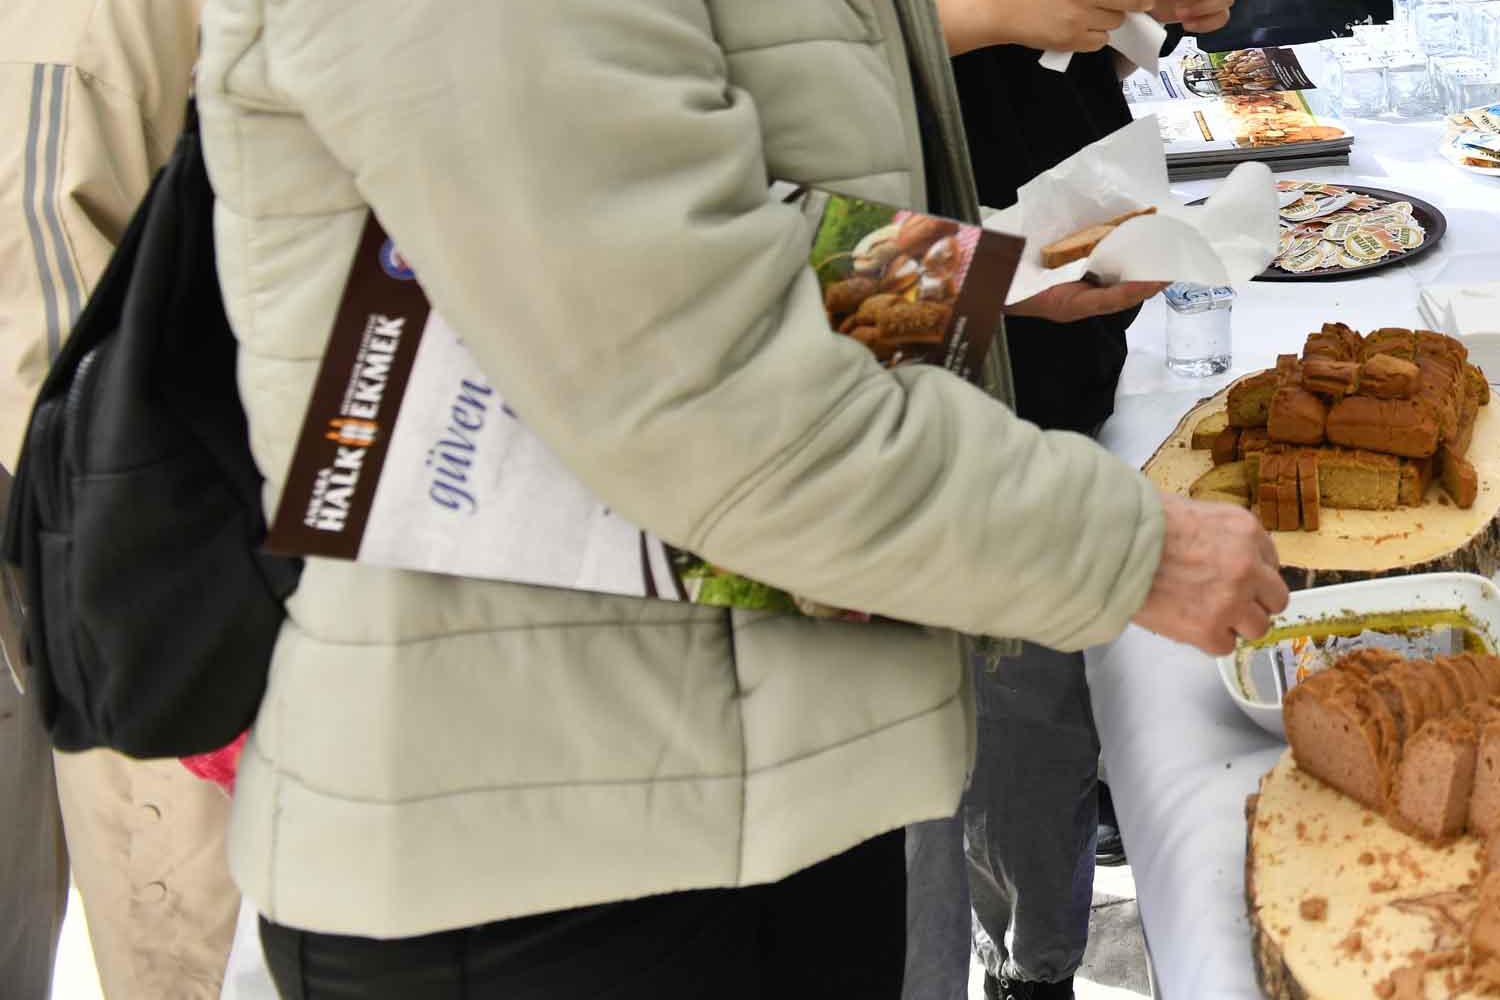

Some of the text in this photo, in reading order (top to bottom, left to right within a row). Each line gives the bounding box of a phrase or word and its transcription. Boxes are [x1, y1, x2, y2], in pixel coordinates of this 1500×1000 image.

[314, 446, 367, 532] HALK
[350, 315, 407, 420] EKMEK
[425, 378, 494, 517] güven
